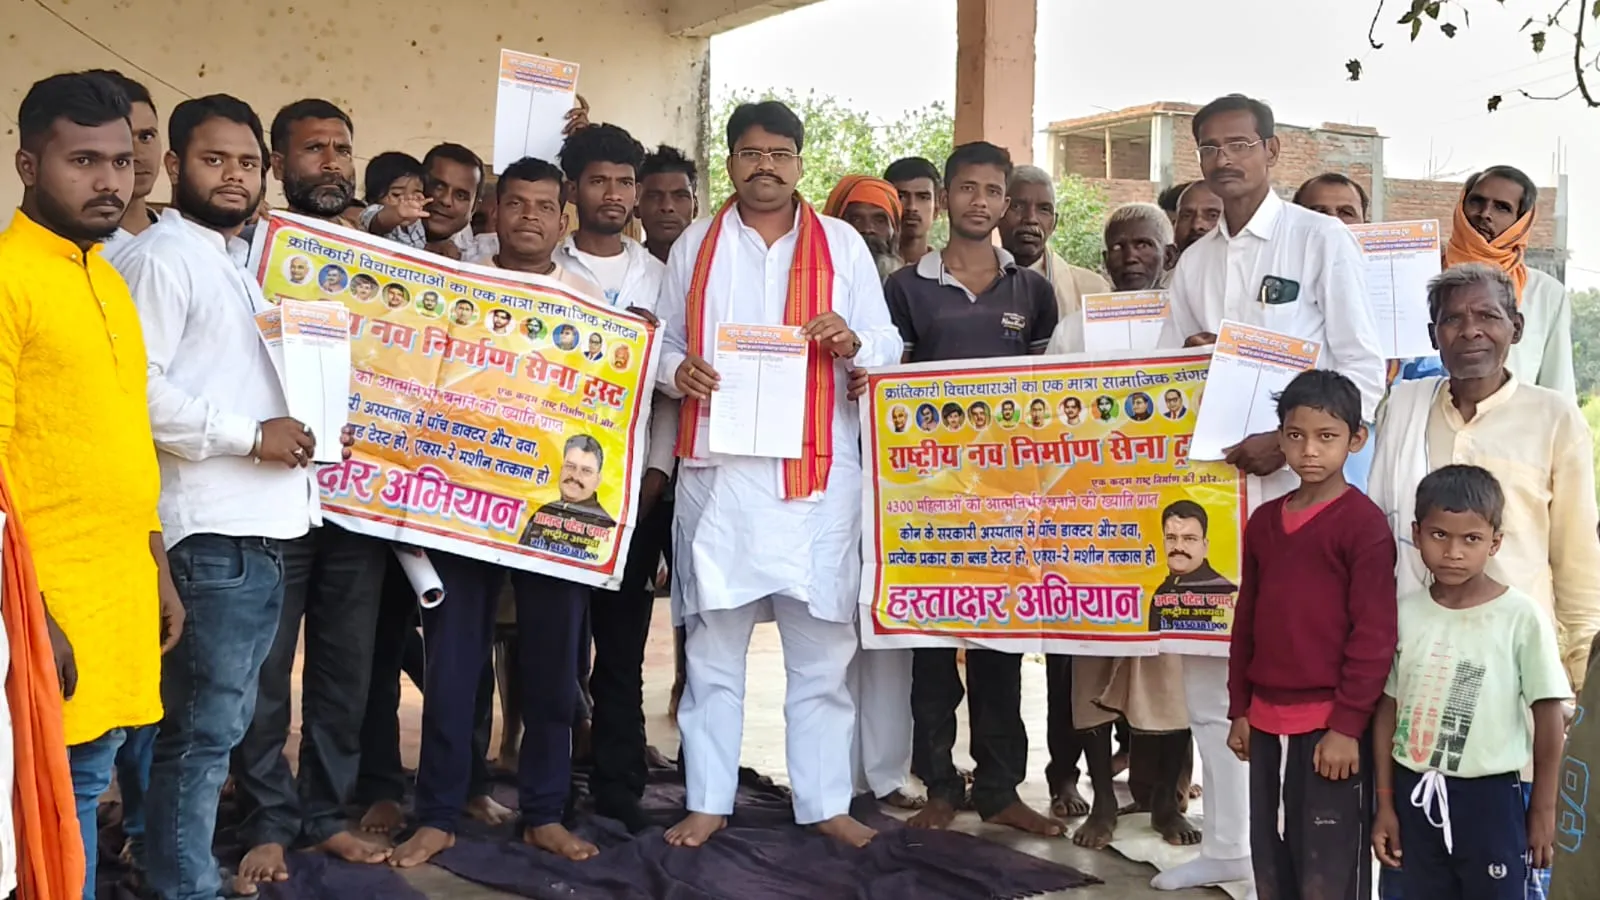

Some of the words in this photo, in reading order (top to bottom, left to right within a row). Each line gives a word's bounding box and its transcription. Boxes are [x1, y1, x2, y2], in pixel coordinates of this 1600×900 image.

[287, 236, 354, 264] क्रांतिकारी
[360, 252, 444, 288] विचारधाराओं
[450, 280, 466, 294] का
[472, 286, 496, 301] एक
[500, 294, 532, 310] मात्रा
[538, 301, 600, 326] सामाजिक
[371, 318, 416, 349] नव
[424, 326, 518, 374] निर्माण
[526, 351, 578, 391] सेना
[584, 374, 626, 407] ट्रस्ट
[356, 370, 374, 384] को
[444, 391, 476, 408] बनाने
[480, 396, 497, 416] की
[500, 404, 538, 424] ख्याति
[498, 388, 512, 396] एक
[885, 382, 939, 400] क्रांतिकारी
[944, 378, 1016, 396] विचारधाराओं
[1022, 381, 1037, 393] का
[1042, 380, 1063, 392] एक
[1068, 378, 1098, 390] मात्रा
[1102, 371, 1170, 388] सामाजिक
[364, 401, 412, 424] अस्पताल
[416, 409, 424, 426] में
[452, 422, 487, 442] डाक्टर
[490, 428, 512, 448] और
[516, 438, 538, 458] दवा,
[368, 423, 392, 444] टेस्ट
[394, 431, 409, 452] हो,
[416, 439, 456, 460] एक्स-रे
[459, 450, 492, 469] मशीन
[495, 460, 534, 480] तत्काल
[536, 466, 549, 484] हो
[888, 439, 960, 475] राष्ट्रीय
[967, 442, 1004, 466] नव
[1010, 432, 1100, 466] निर्माण
[1108, 430, 1166, 461] सेना
[382, 464, 524, 529] अभियान
[886, 500, 914, 512] 4300
[917, 496, 962, 512] महिलाओं
[966, 495, 980, 510] को
[1080, 490, 1096, 508] की
[1101, 490, 1134, 508] ख्याति
[1136, 494, 1158, 508] प्राप्त
[1091, 478, 1106, 488] एक
[1183, 472, 1194, 483] की
[900, 523, 920, 540] कोन
[924, 522, 934, 539] के
[937, 522, 976, 540] सरकारी
[980, 526, 1023, 539] अस्पताल
[1027, 520, 1036, 538] में
[1060, 524, 1092, 536] डाक्टर
[1098, 519, 1118, 536] और
[1120, 524, 1141, 539] दवा,
[888, 548, 916, 564] प्रत्येक
[920, 552, 946, 564] प्रकार
[950, 552, 964, 564] का
[990, 546, 1011, 563] टेस्ट
[1015, 545, 1029, 566] हो,
[1033, 545, 1070, 564] एक्स-रे
[1074, 544, 1104, 563] मशीन
[1108, 550, 1142, 563] तत्काल
[1146, 544, 1155, 564] हो
[887, 586, 1008, 620] हस्ताक्षर
[1016, 574, 1141, 619] अभियान
